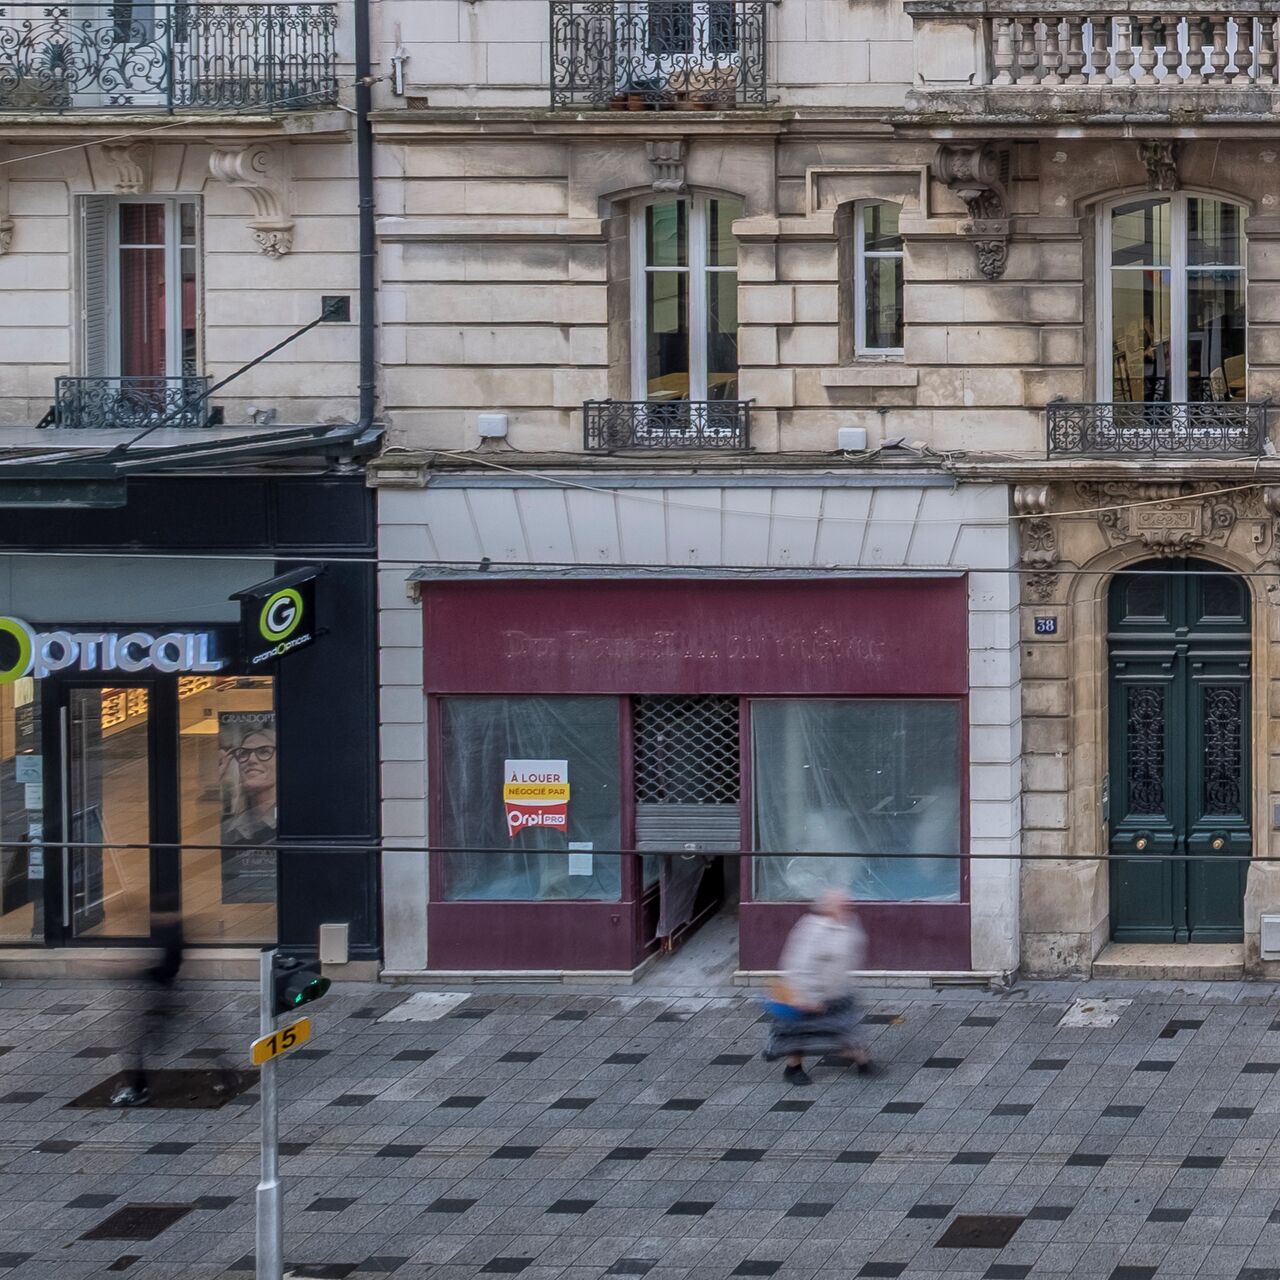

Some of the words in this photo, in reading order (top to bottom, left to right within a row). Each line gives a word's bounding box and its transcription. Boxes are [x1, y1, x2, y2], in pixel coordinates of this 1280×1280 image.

[1037, 619, 1055, 632] 38
[511, 771, 518, 783] À
[521, 774, 561, 783] LOUER
[508, 787, 546, 796] NÉGOCIÉ
[508, 810, 542, 827] Orpi
[266, 1027, 297, 1055] 15
